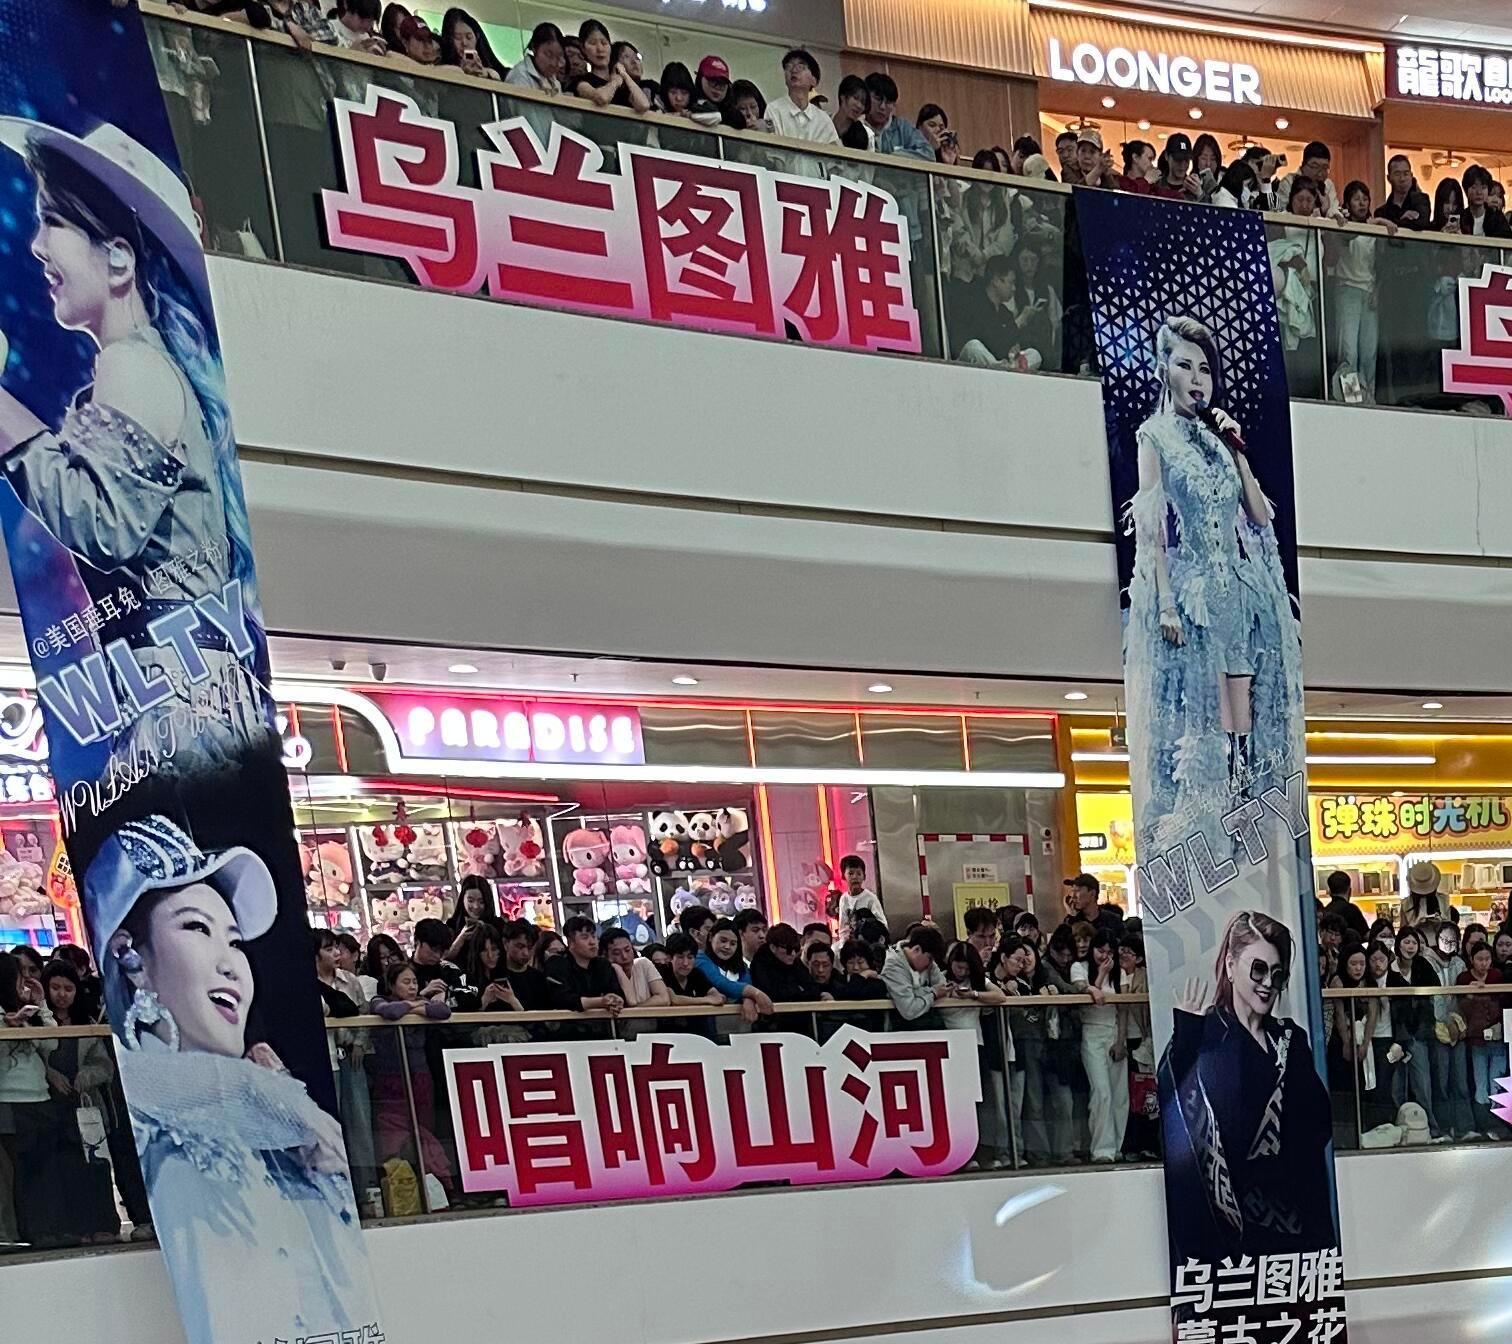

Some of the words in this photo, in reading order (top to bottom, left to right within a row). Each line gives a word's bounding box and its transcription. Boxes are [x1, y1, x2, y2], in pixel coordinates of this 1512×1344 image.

[1048, 38, 1262, 105] LOONGER
[338, 96, 914, 347] 乌兰图雅
[37, 578, 254, 746] WLTY
[408, 706, 635, 754] PARADISE
[1137, 770, 1310, 924] WLTY
[1321, 794, 1509, 840] 弹珠时光机
[452, 1038, 951, 1195] 唱响山河
[1170, 1247, 1346, 1314] 乌兰图雅
